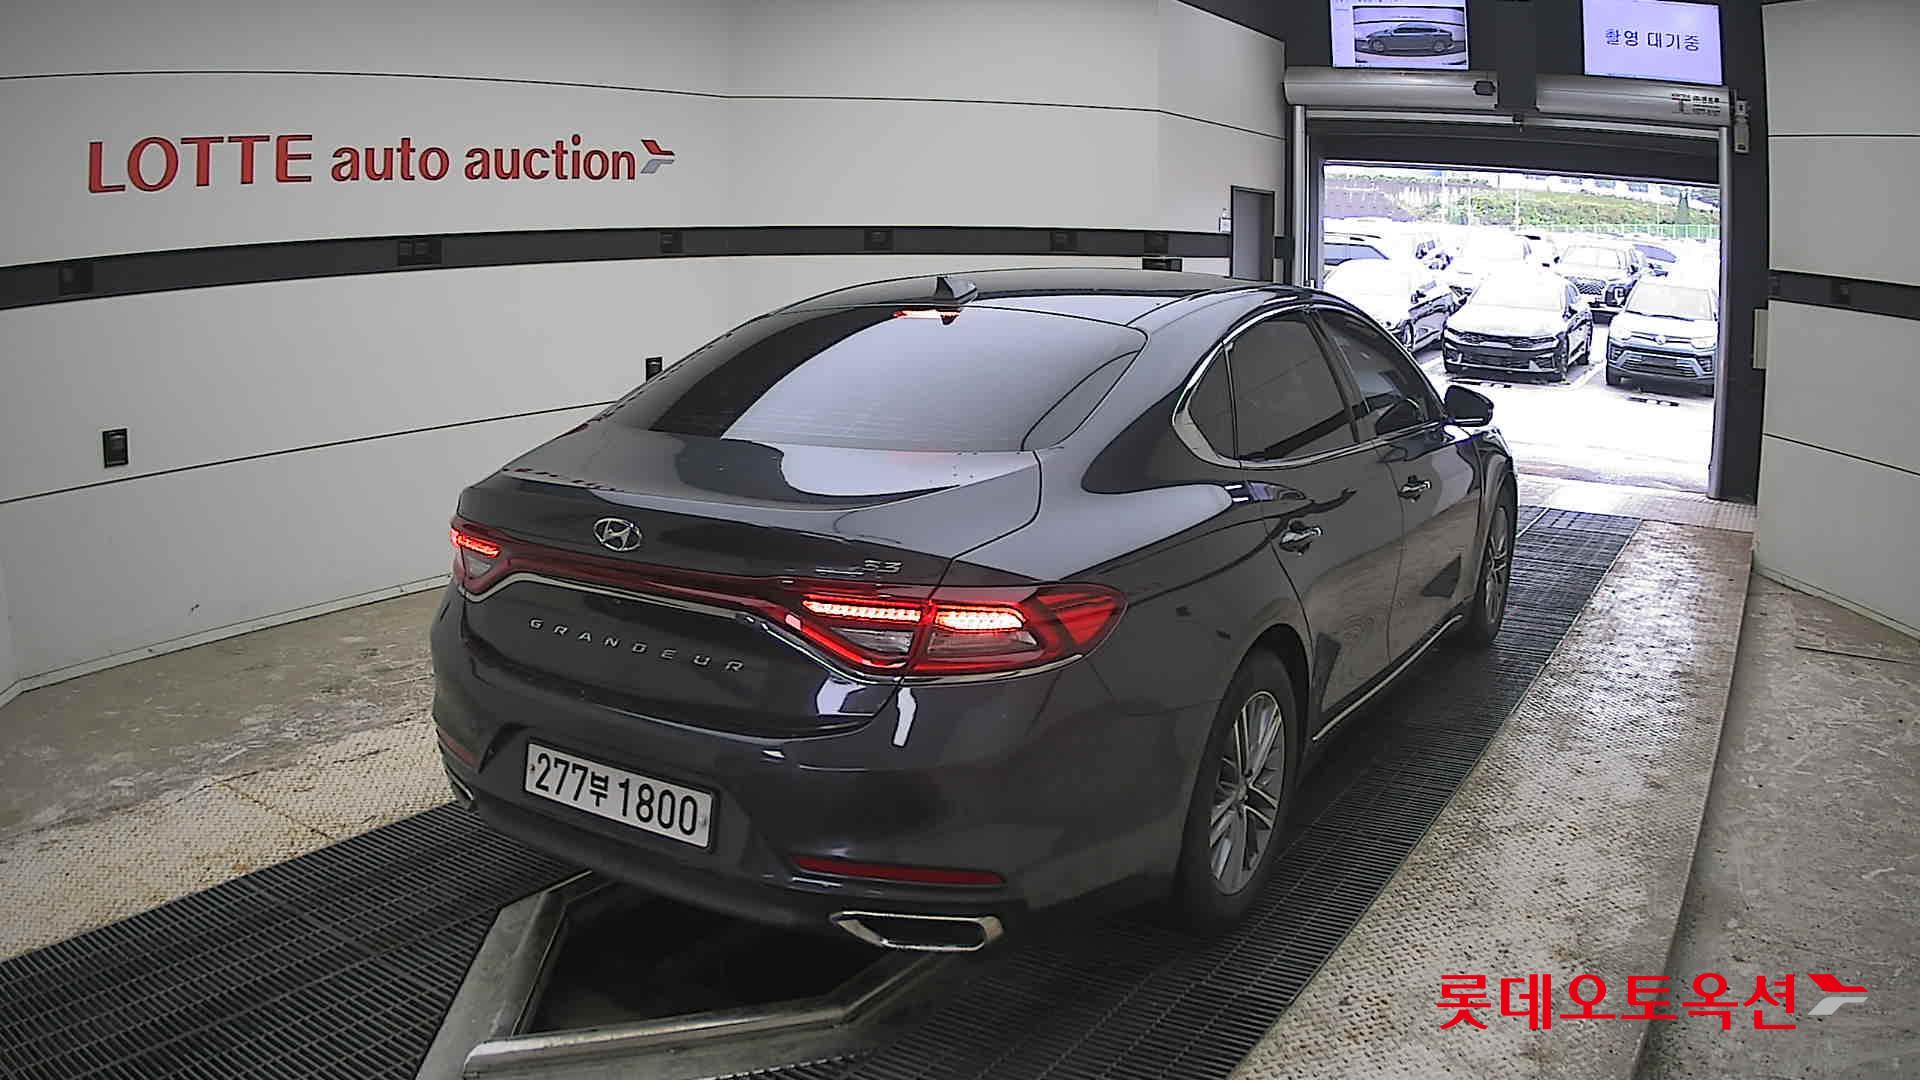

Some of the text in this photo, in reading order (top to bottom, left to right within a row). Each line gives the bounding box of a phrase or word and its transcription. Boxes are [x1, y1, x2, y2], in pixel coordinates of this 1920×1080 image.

[1647, 31, 1700, 51] 대기중
[88, 134, 637, 193] LOTTE auto auction
[529, 617, 744, 672] GRANDEUR
